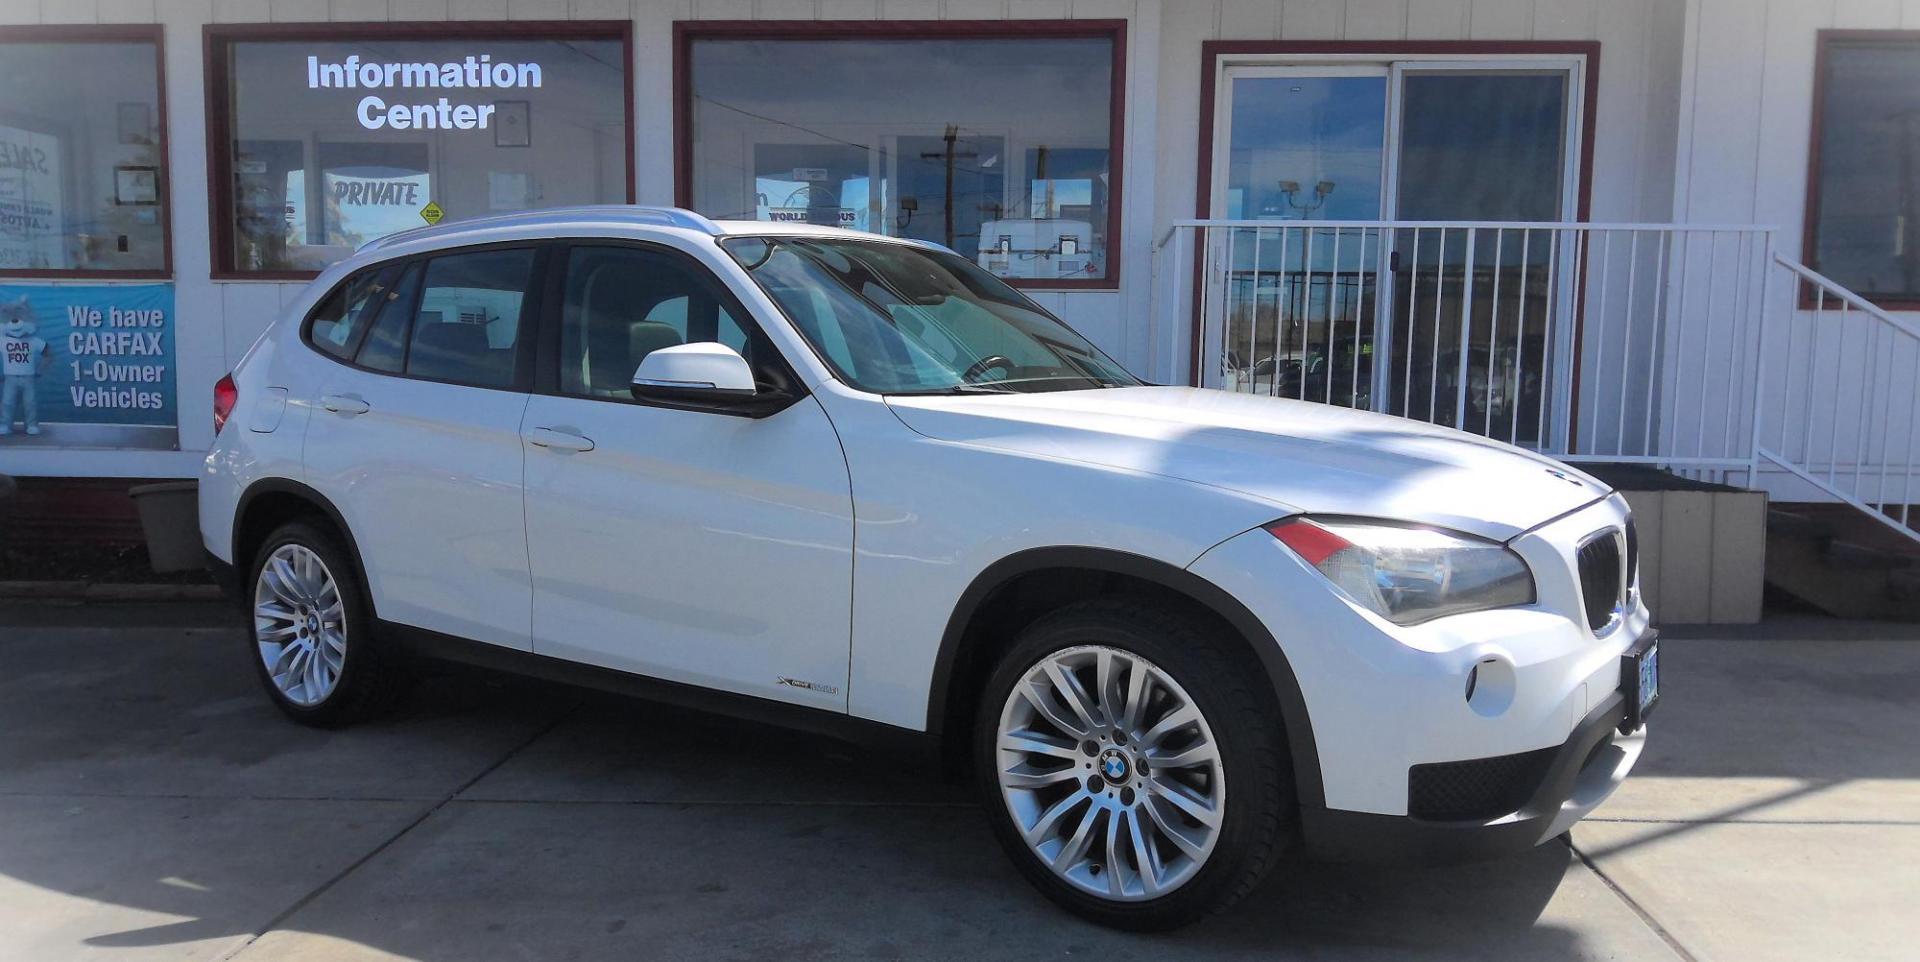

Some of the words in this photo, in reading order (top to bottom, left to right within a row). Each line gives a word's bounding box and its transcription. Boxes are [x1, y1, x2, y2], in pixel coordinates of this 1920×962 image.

[307, 55, 542, 88] Information
[357, 95, 495, 129] Center
[334, 180, 419, 206] PRIVATE
[768, 211, 808, 222] WORLD
[67, 305, 102, 328] We
[109, 305, 164, 328] have
[6, 342, 30, 352] CAR
[68, 331, 163, 355] CARFAX
[8, 352, 30, 364] FOX
[70, 359, 165, 383] 1-Owner
[70, 385, 163, 409] Vehicles
